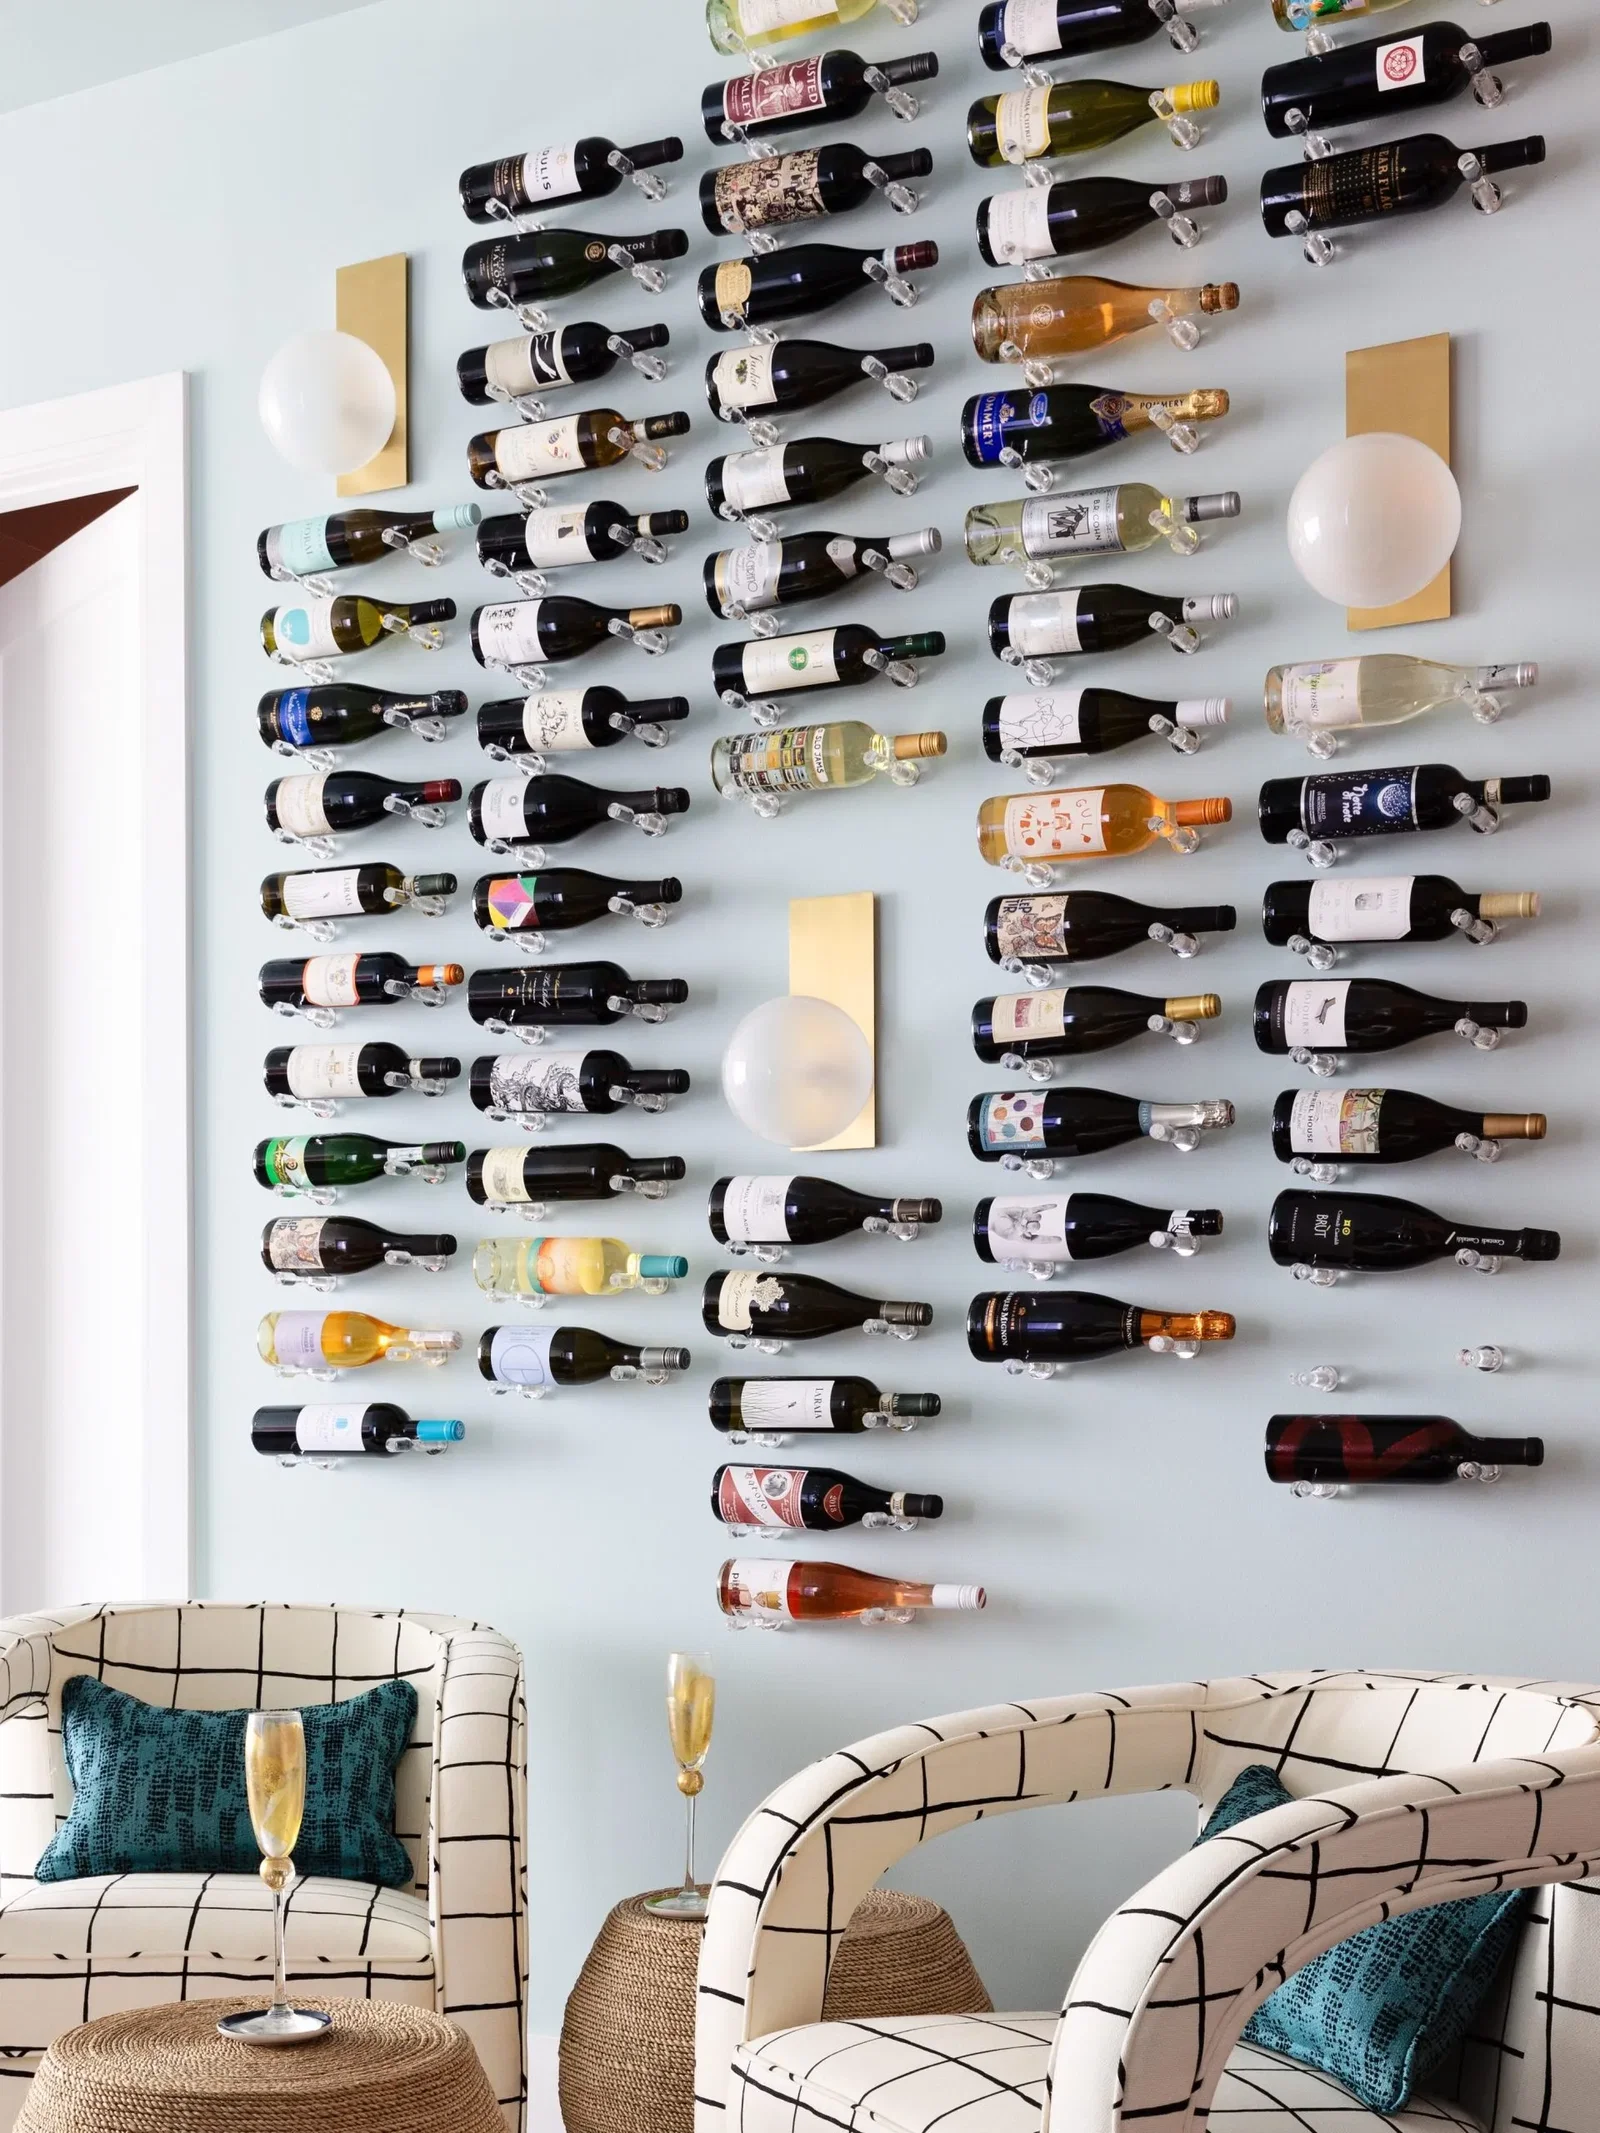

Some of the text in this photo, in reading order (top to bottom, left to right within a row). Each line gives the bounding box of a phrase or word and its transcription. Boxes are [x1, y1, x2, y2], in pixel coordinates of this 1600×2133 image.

[739, 75, 754, 118] VALLEY
[491, 244, 504, 288] HATON
[813, 735, 825, 775] SLO JAMS
[1019, 804, 1038, 847] HABLO
[1075, 798, 1094, 845] GULP
[1341, 801, 1353, 824] note
[1306, 1115, 1316, 1144] HOUSE
[1000, 1311, 1010, 1347] MIGNON
